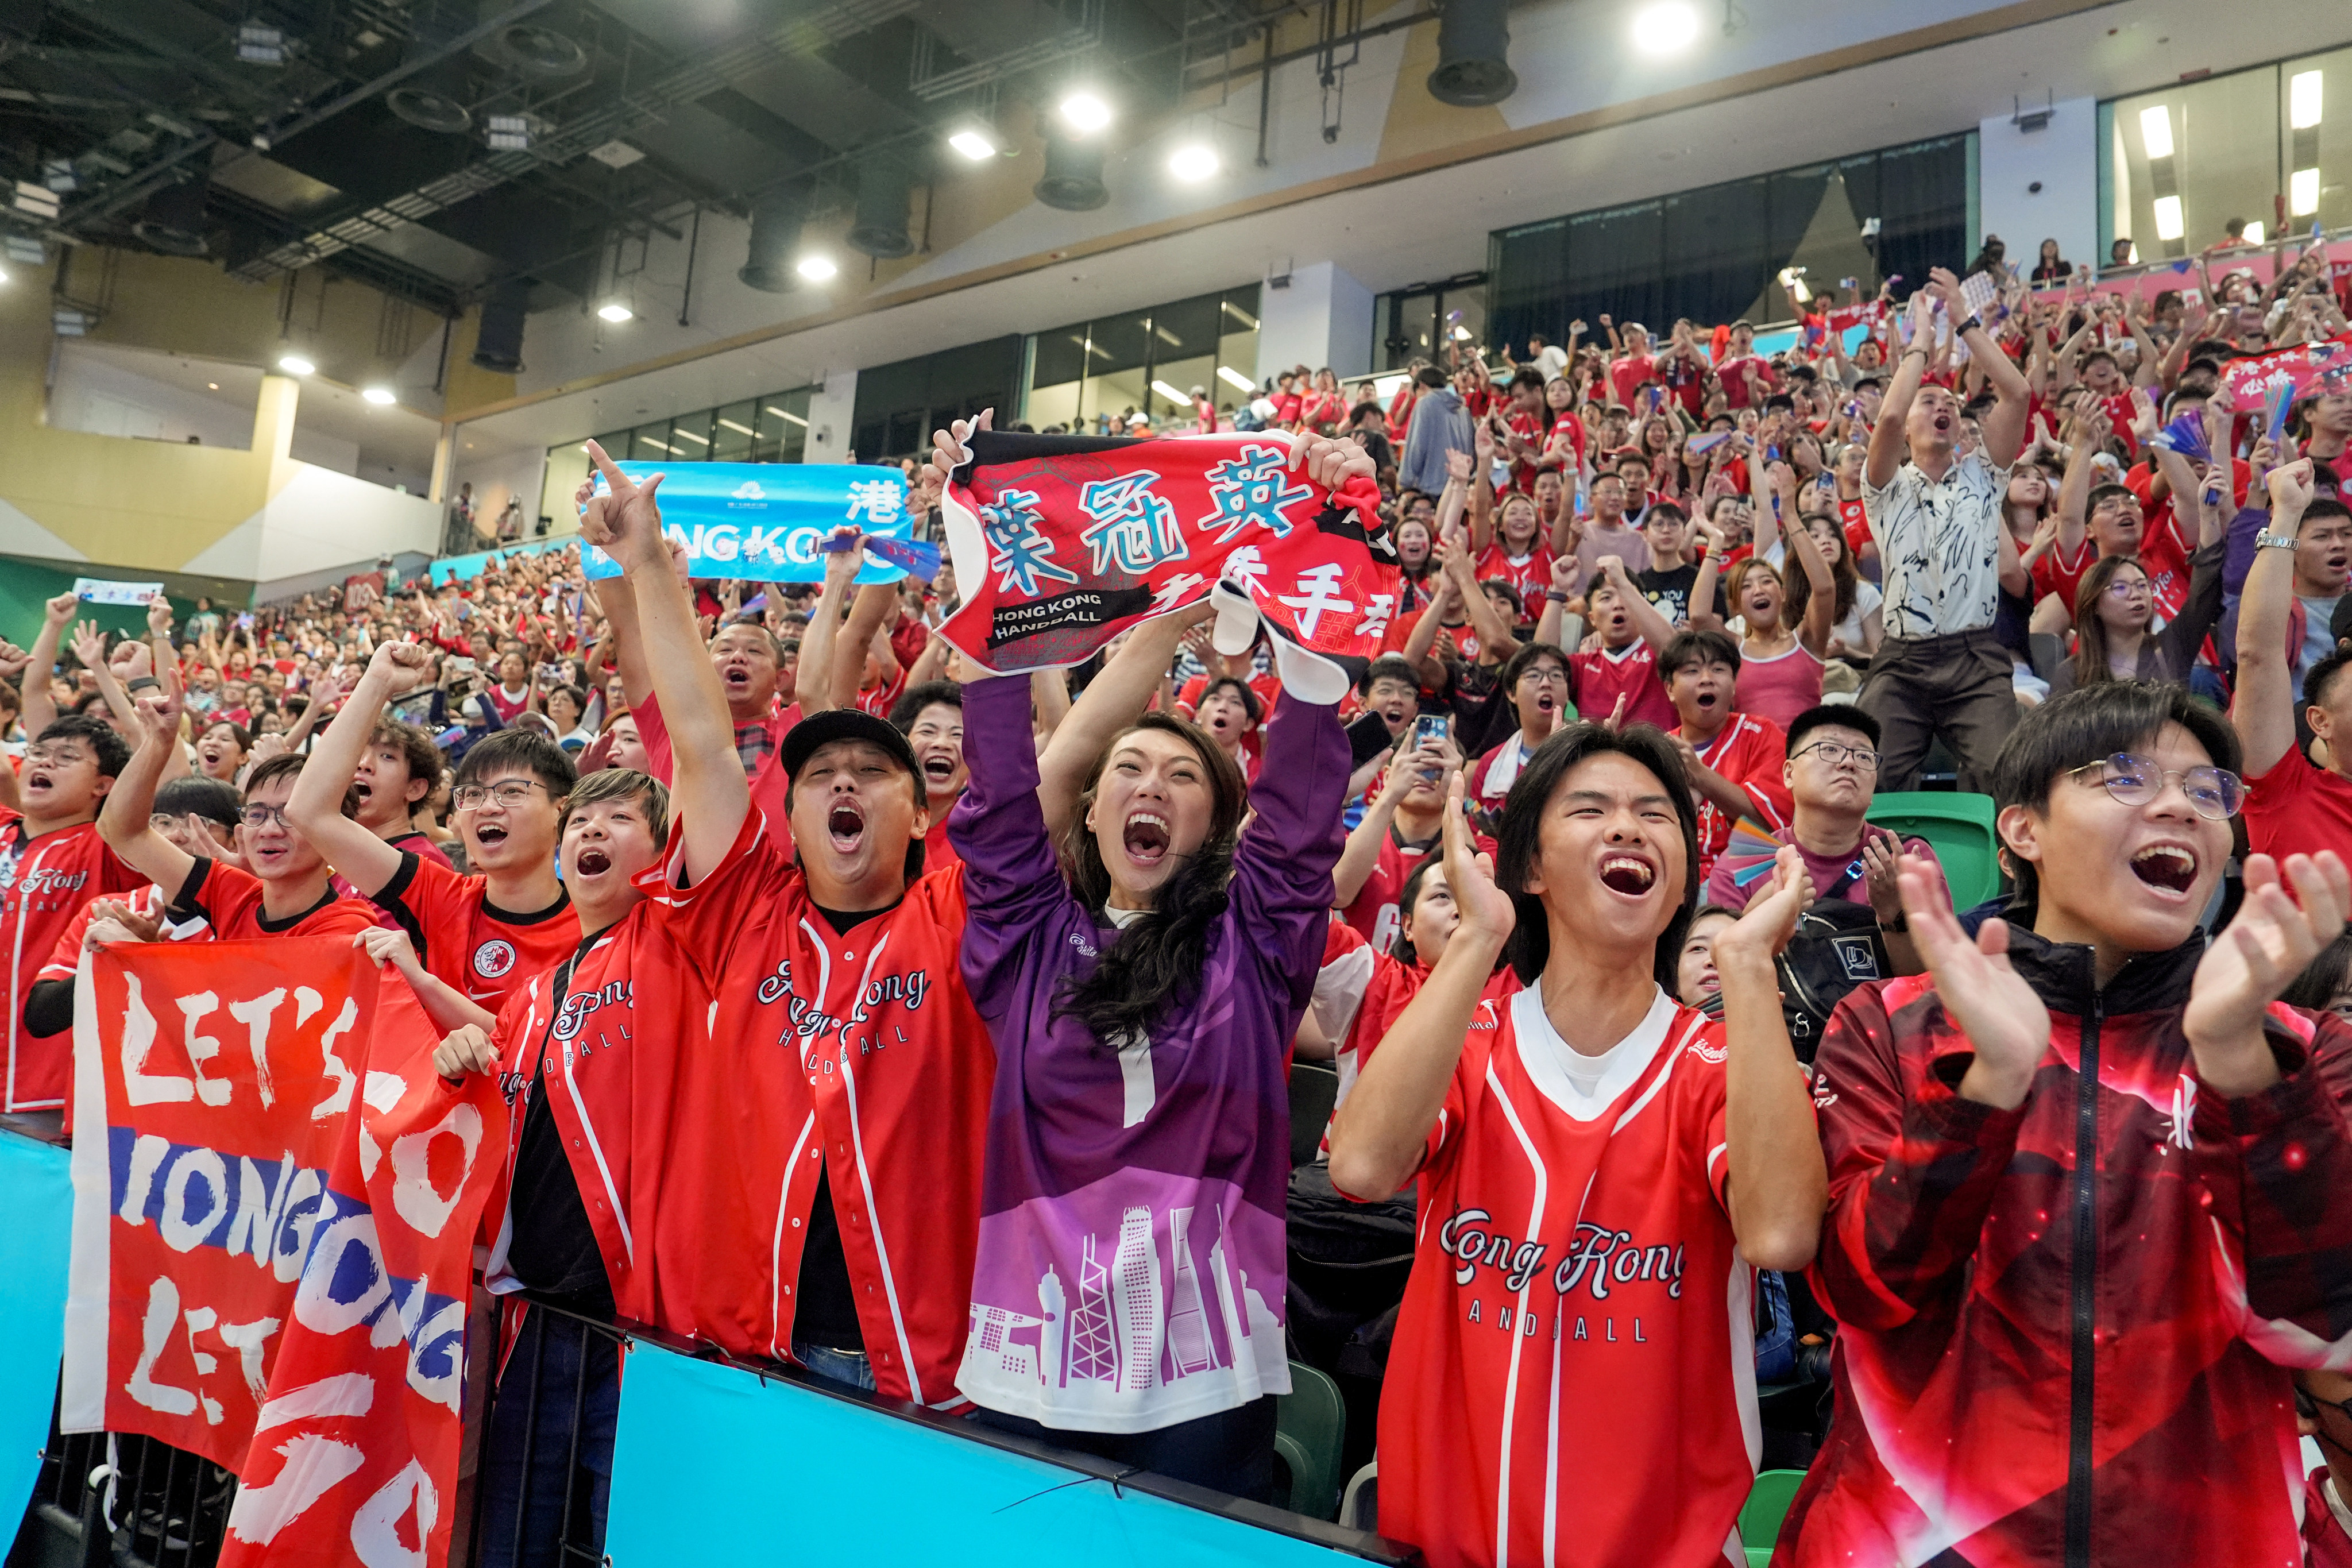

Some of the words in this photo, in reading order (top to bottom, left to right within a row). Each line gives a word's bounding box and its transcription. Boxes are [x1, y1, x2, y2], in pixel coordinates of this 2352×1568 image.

[993, 605, 1046, 623] HONG
[1049, 594, 1102, 617] KONG
[995, 611, 1101, 640] HANDBALL
[491, 947, 504, 955] HK
[121, 971, 360, 1129] LET'S
[1105, 1025, 1156, 1129] 1
